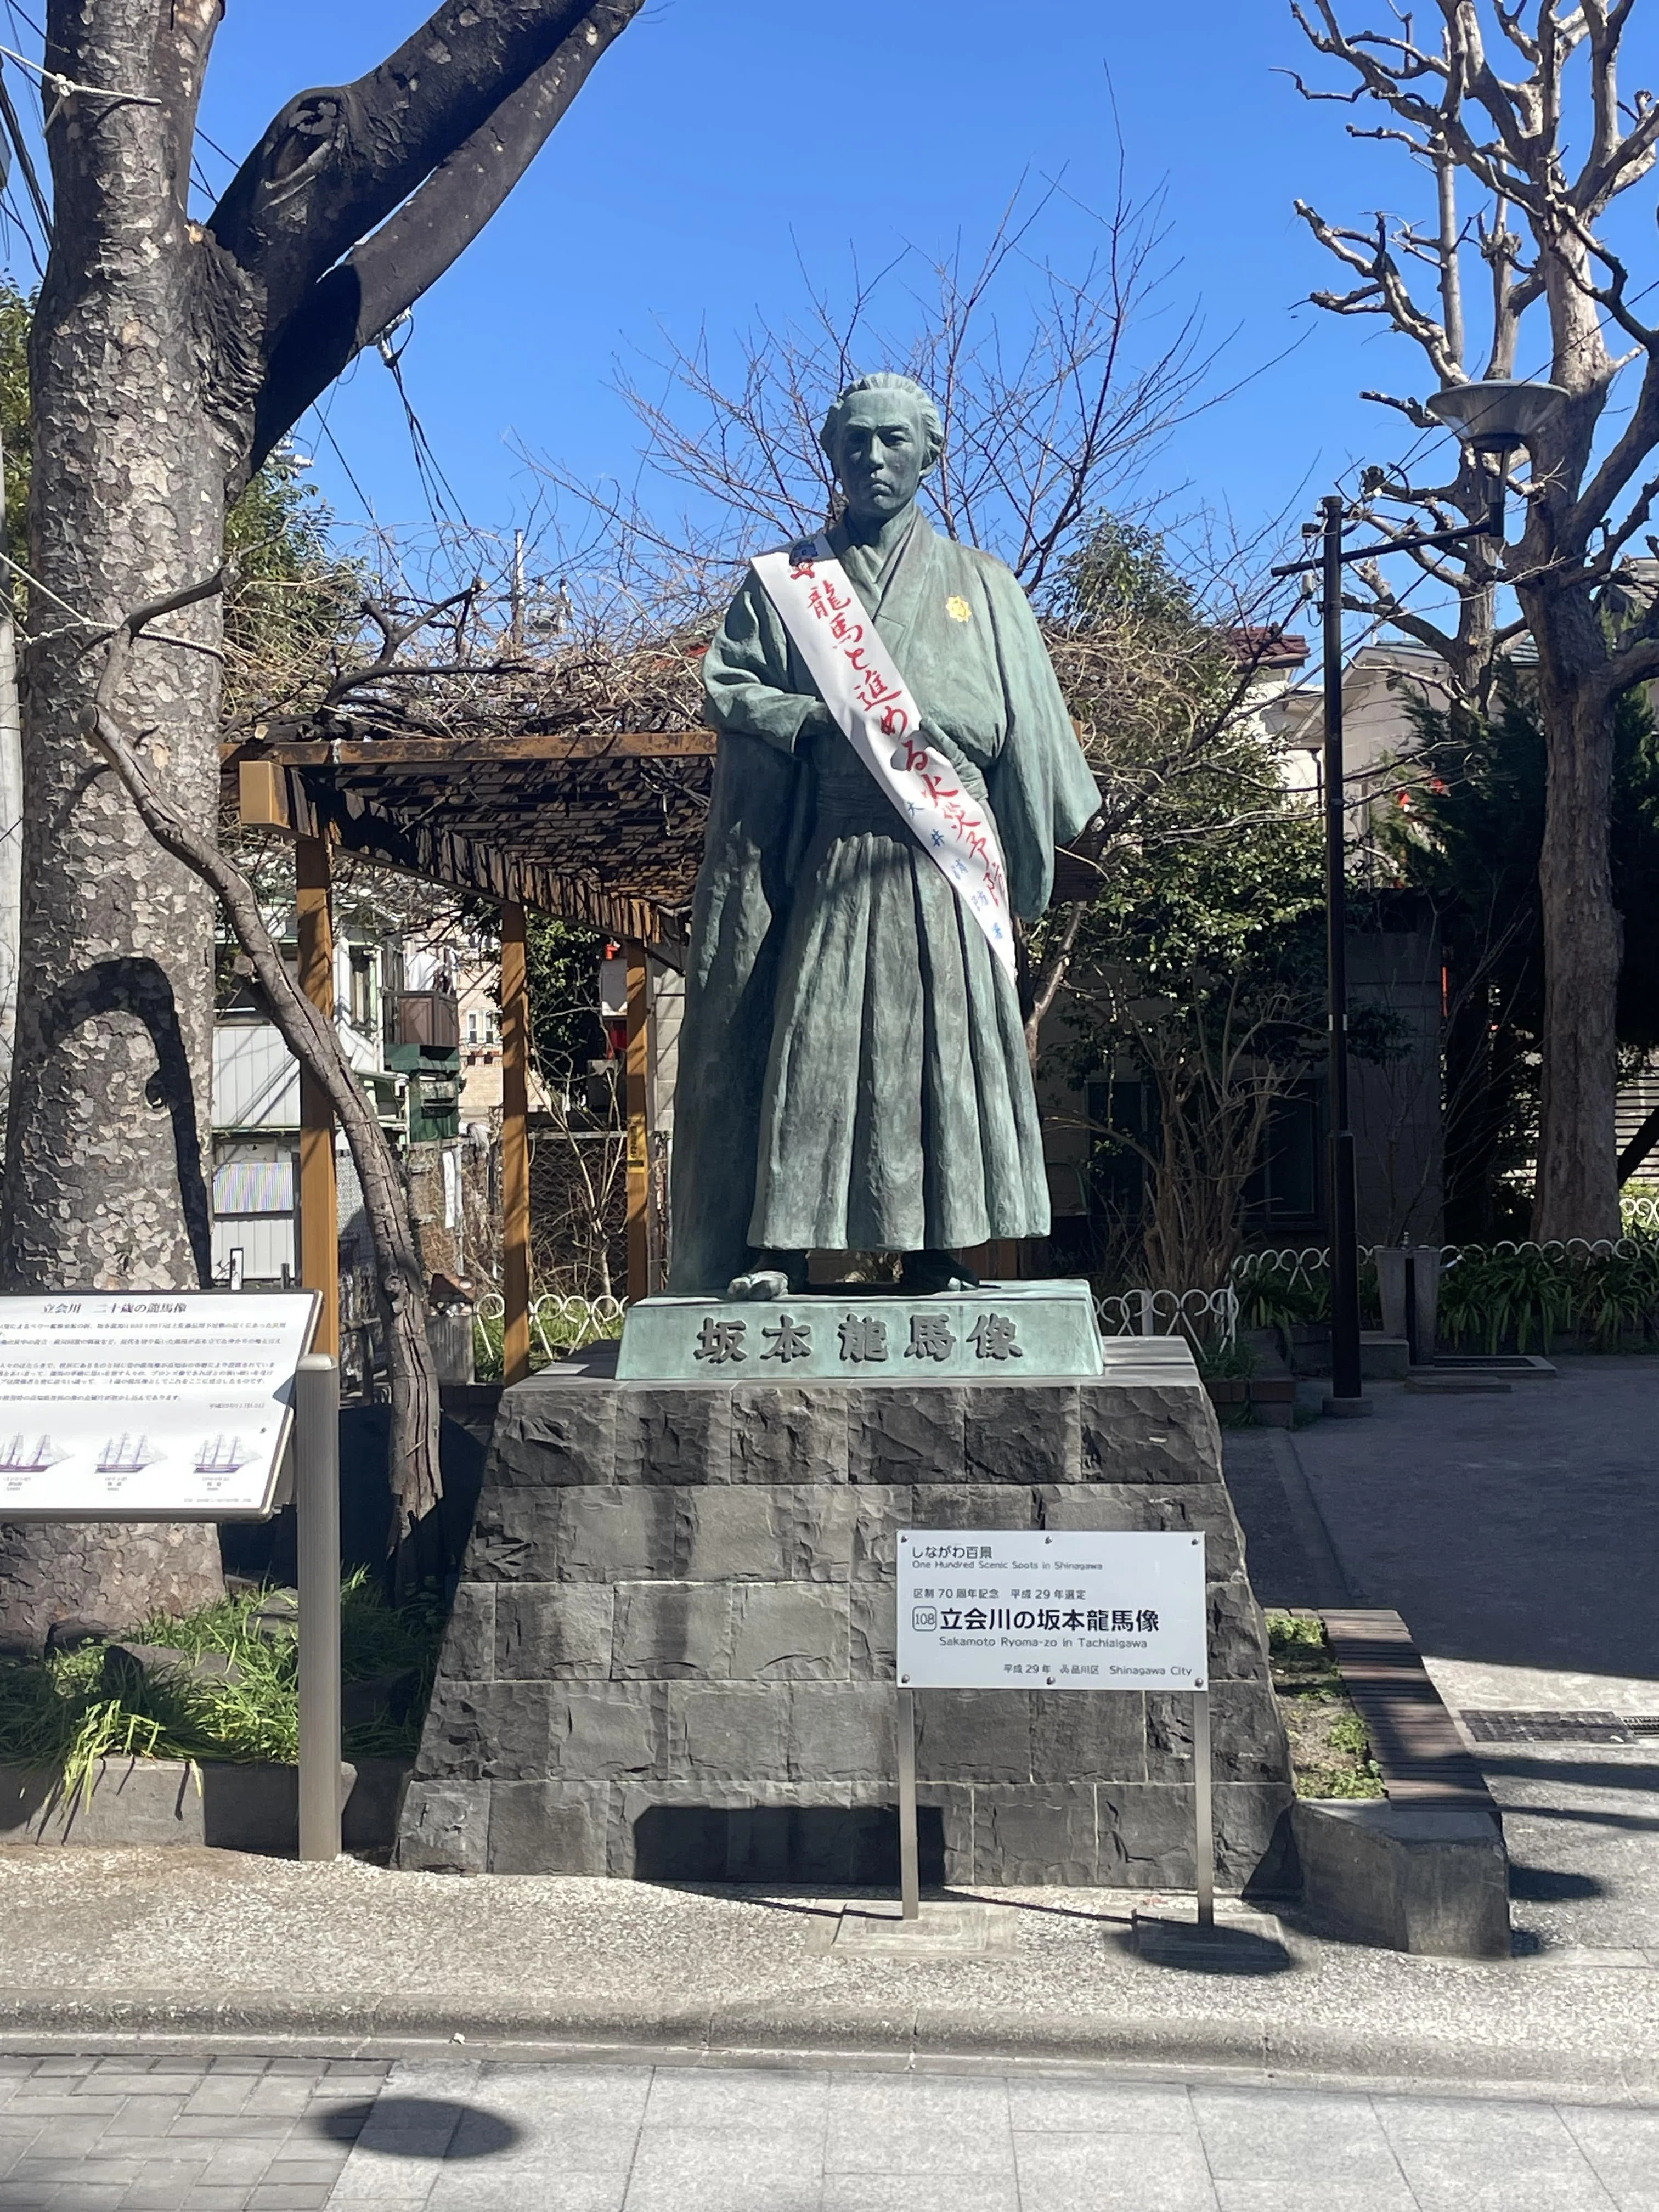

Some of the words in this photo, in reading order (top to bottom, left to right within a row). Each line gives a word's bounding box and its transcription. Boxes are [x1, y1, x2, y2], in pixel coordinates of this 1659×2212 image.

[693, 1314, 1024, 1363] 坂本龍馬像
[912, 1545, 992, 1559] しながわ百景
[912, 1560, 932, 1569] One
[935, 1560, 974, 1570] Hundred
[978, 1560, 1009, 1570] Scenic
[1012, 1560, 1039, 1570] Spots
[1042, 1561, 1051, 1570] in
[1054, 1561, 1103, 1571] Shinagawa
[915, 1613, 935, 1626] 108
[940, 1607, 1160, 1632] 立会川の坂本龍馬像
[939, 1636, 996, 1647] Sakamoto
[1001, 1637, 1058, 1649] Ryoma-zo
[1062, 1637, 1073, 1647] in
[1077, 1637, 1148, 1649] Tachiaigawa
[1109, 1664, 1166, 1677] Shinagawa
[1170, 1666, 1192, 1677] City
